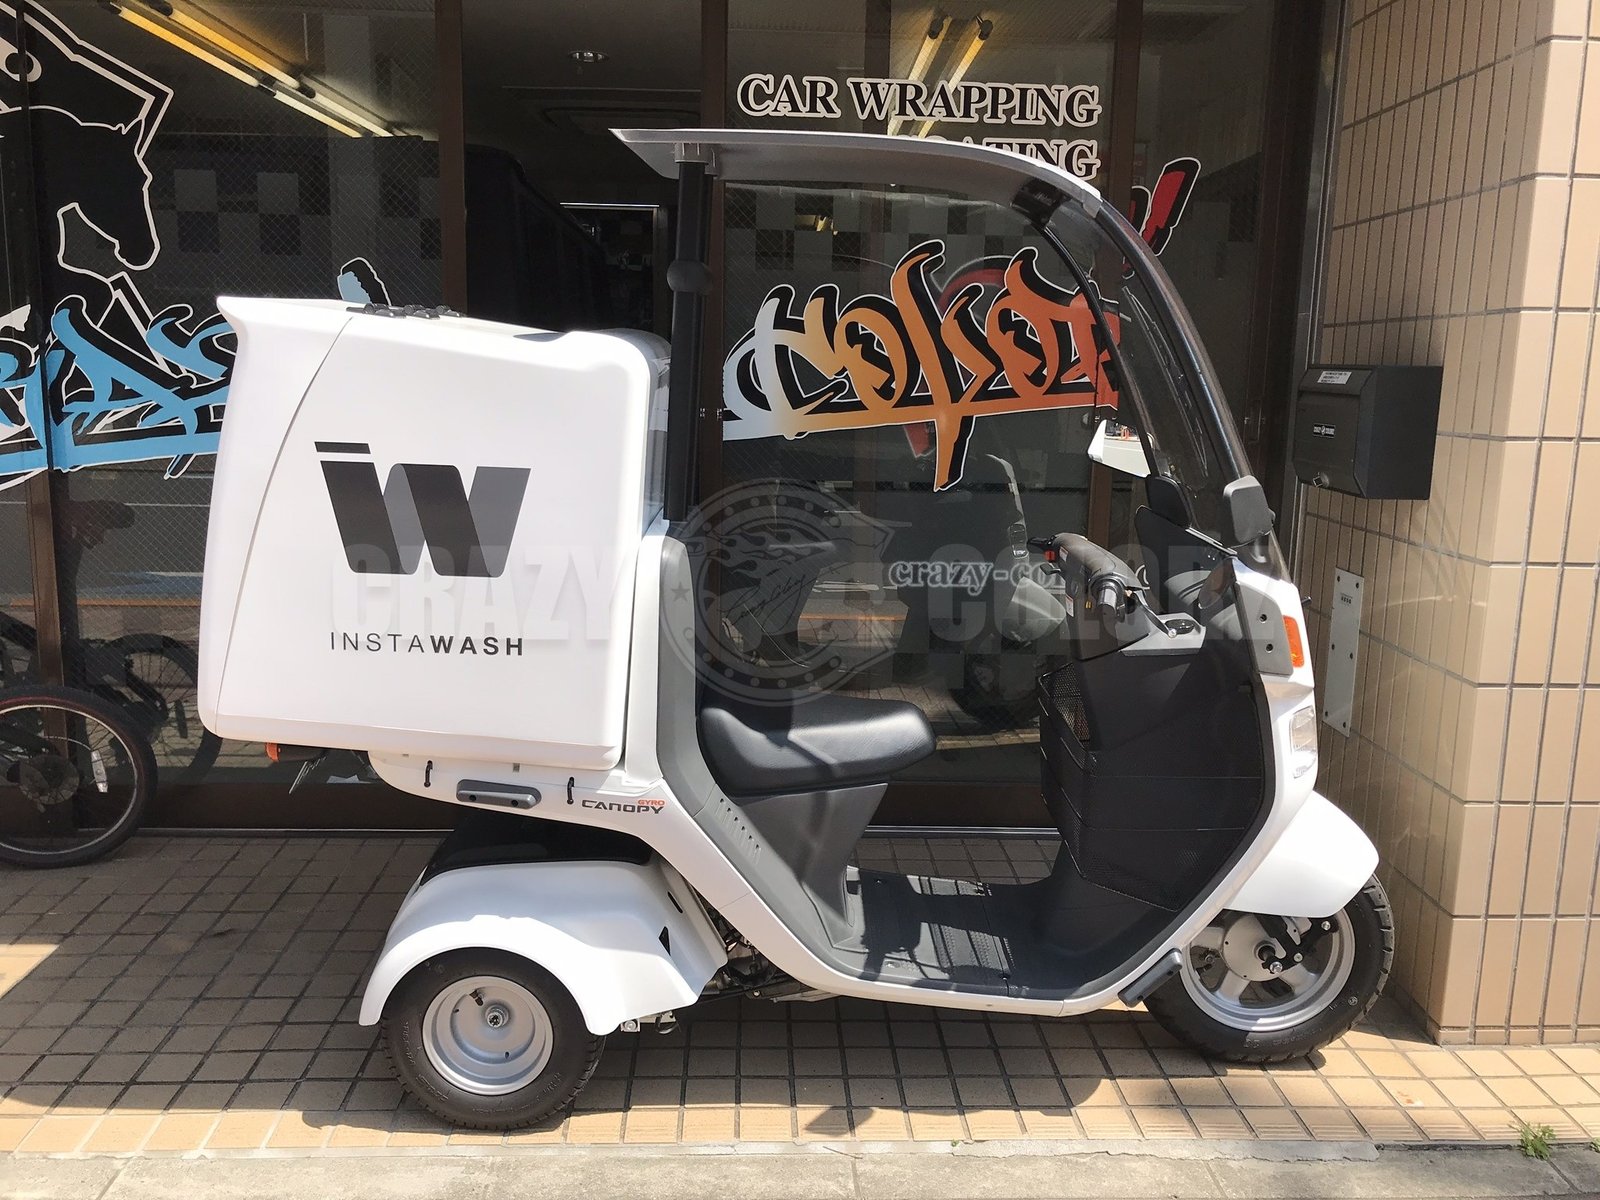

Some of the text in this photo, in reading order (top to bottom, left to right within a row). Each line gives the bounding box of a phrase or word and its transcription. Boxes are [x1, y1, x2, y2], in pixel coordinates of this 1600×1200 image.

[737, 74, 1102, 127] CAR WRAPPING
[329, 631, 524, 656] INSTAWASH
[581, 799, 664, 815] CANOPY
[637, 799, 665, 807] GYRO
